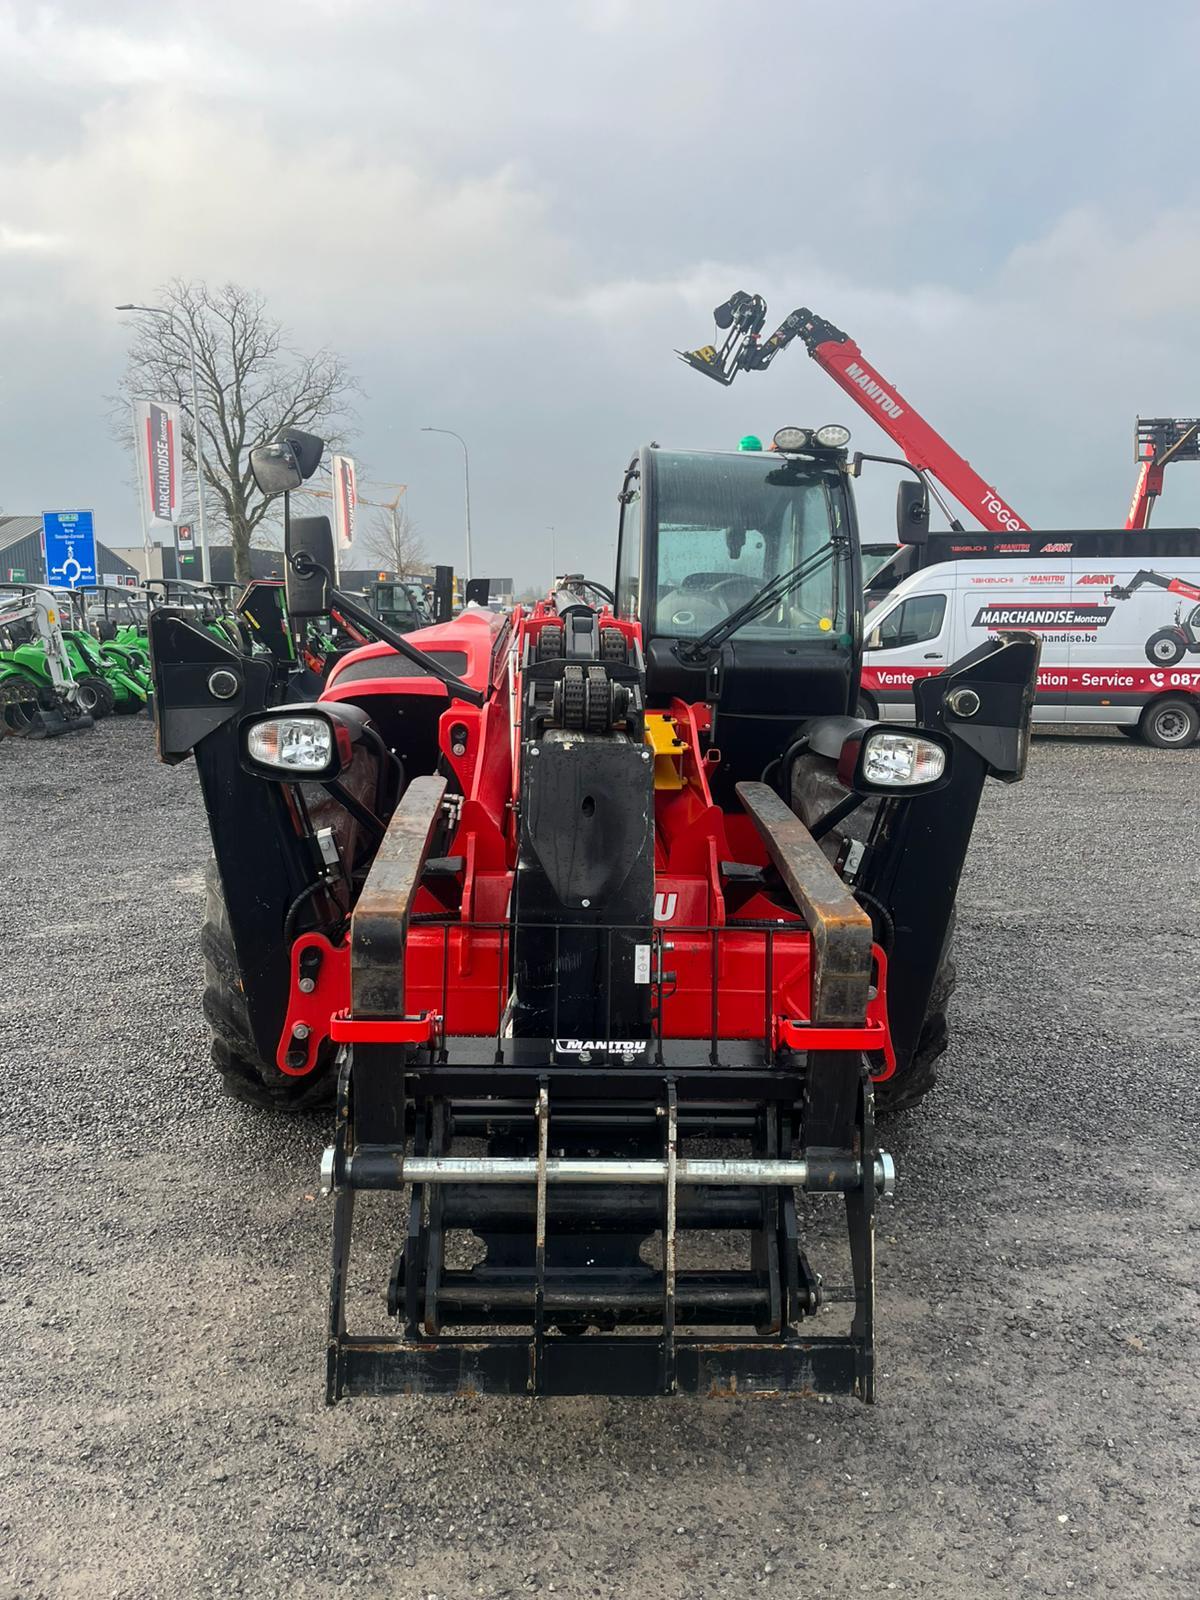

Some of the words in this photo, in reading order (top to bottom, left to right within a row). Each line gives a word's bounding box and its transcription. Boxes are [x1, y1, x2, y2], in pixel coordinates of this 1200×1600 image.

[845, 363, 903, 419] MANITOU
[157, 441, 171, 517] MARCHANDISE
[1040, 543, 1073, 552] AVANT
[1076, 575, 1116, 585] AVANT
[980, 611, 1075, 624] MARCHANDISE
[1074, 615, 1107, 624] Montzen
[877, 672, 915, 684] Vente
[1082, 673, 1134, 686] Service
[1170, 673, 1200, 686] 087
[566, 1040, 646, 1050] MANITOU
